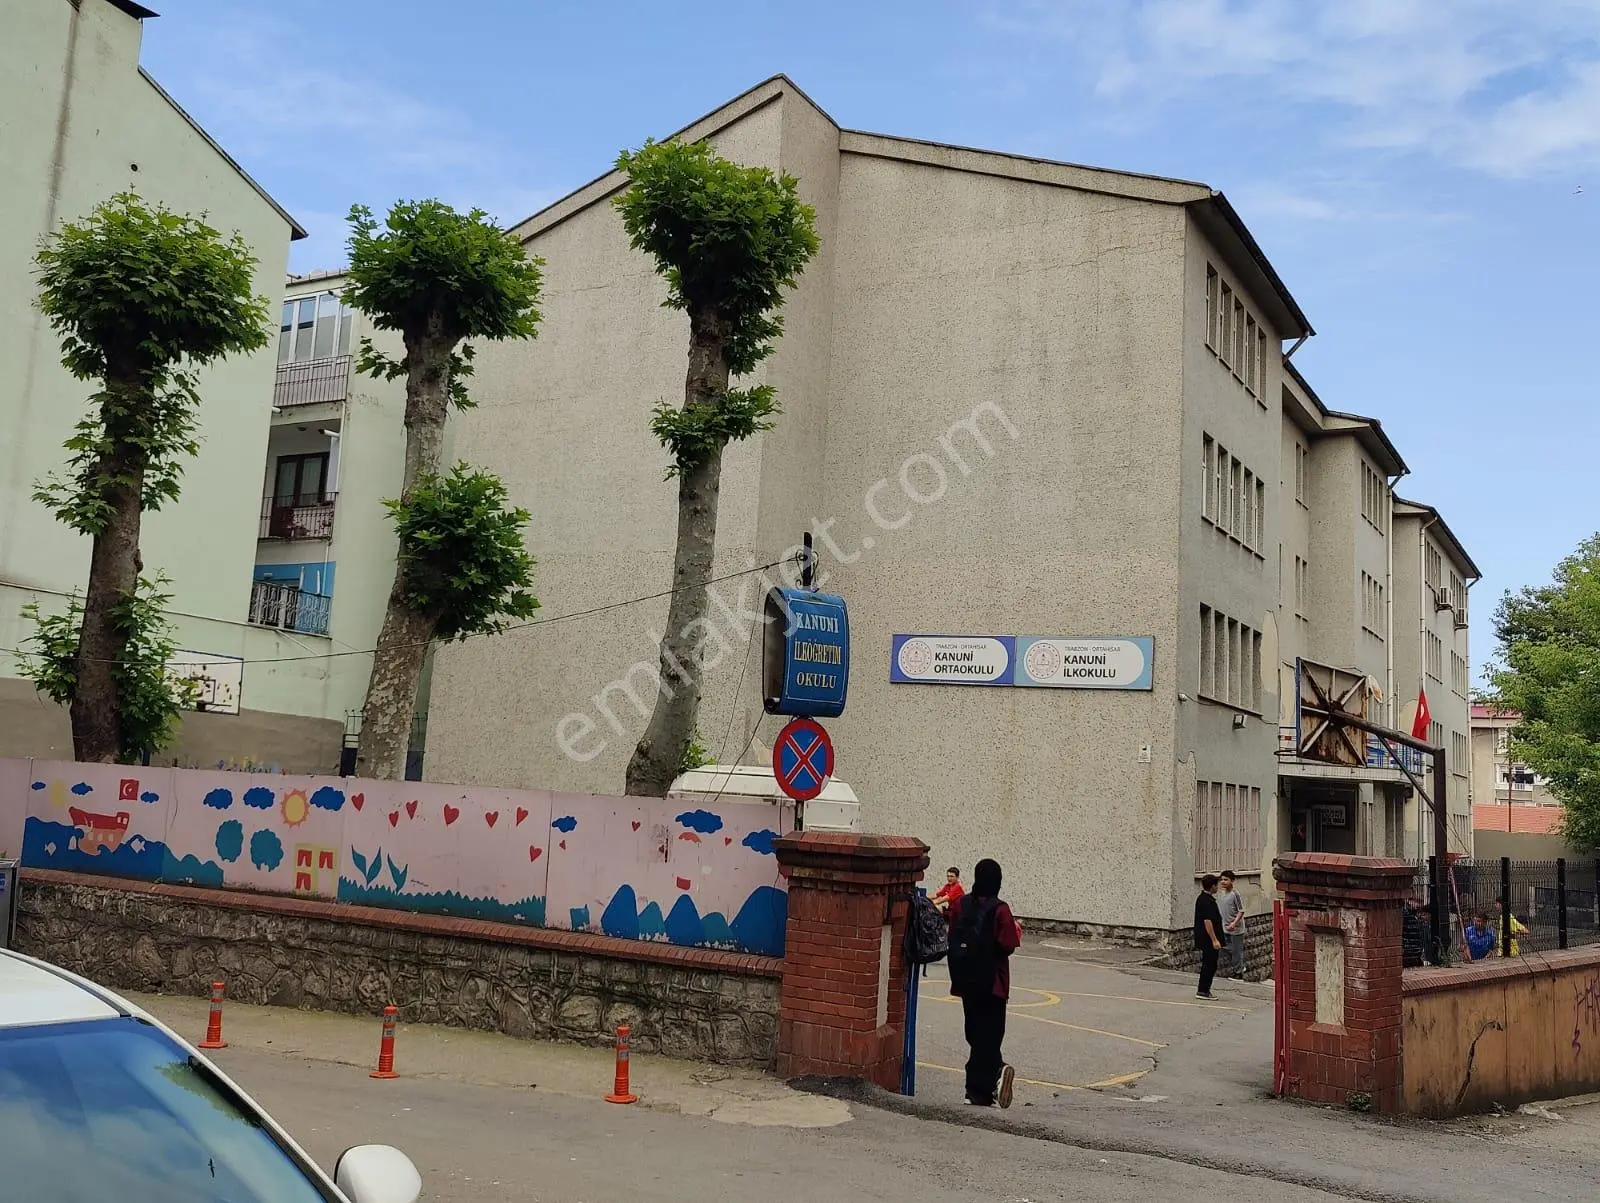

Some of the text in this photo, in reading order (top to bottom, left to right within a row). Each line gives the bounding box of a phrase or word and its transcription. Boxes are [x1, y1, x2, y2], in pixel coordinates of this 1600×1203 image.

[796, 612, 839, 633] KANUNİ
[794, 638, 842, 665] İLKÖĞRETİM
[934, 651, 974, 662] KANUNİ
[1063, 654, 1106, 665] KANUNİ
[934, 664, 994, 674] ORTAOKULU
[1063, 666, 1116, 678] İLKOKULU
[797, 672, 837, 688] OKULU
